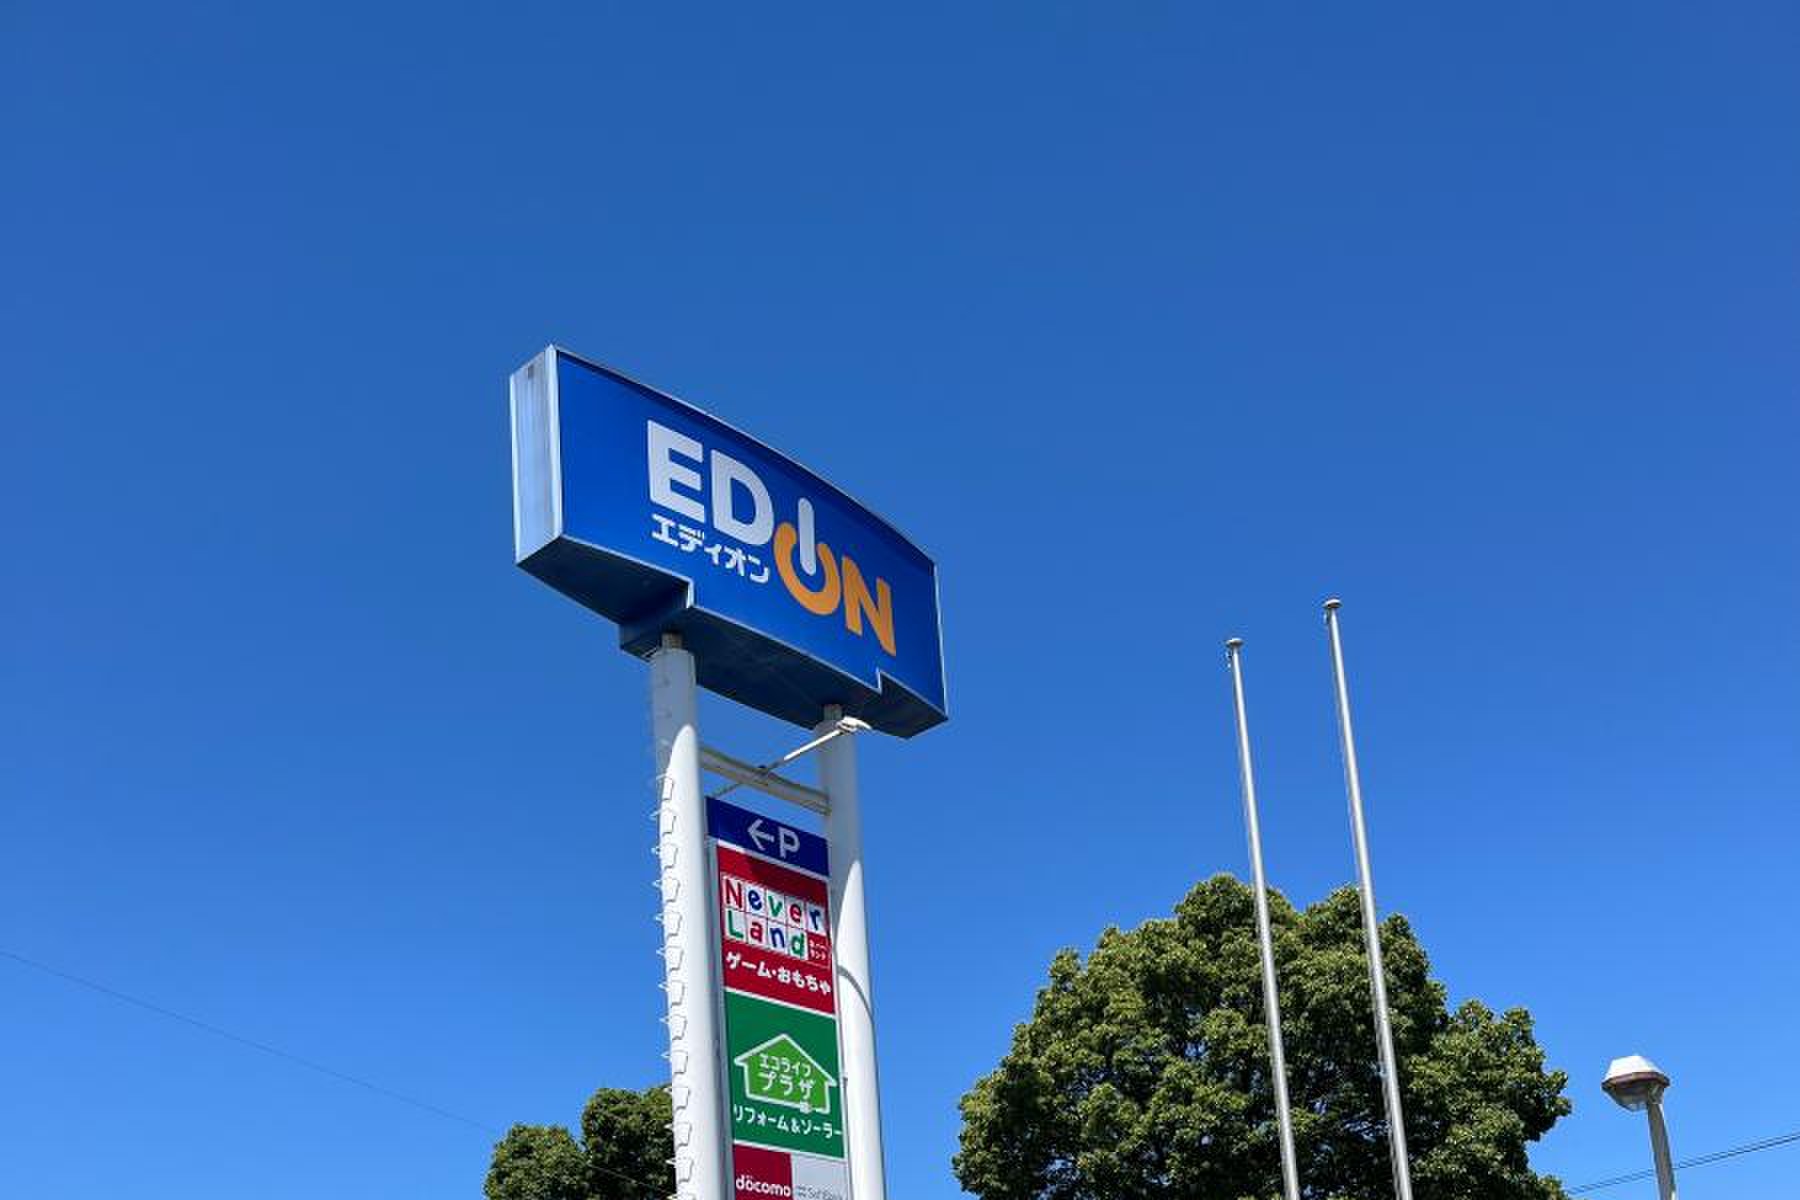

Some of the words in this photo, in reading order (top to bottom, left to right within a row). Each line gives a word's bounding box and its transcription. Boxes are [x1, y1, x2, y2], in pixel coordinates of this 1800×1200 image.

[647, 420, 896, 656] EDION
[652, 512, 769, 583] エディオン
[779, 826, 800, 858] P
[724, 877, 821, 931] Never
[726, 910, 805, 957] Land
[759, 1053, 812, 1077] エコライフ
[757, 1071, 815, 1099] プラザ
[735, 1174, 792, 1197] docomo
